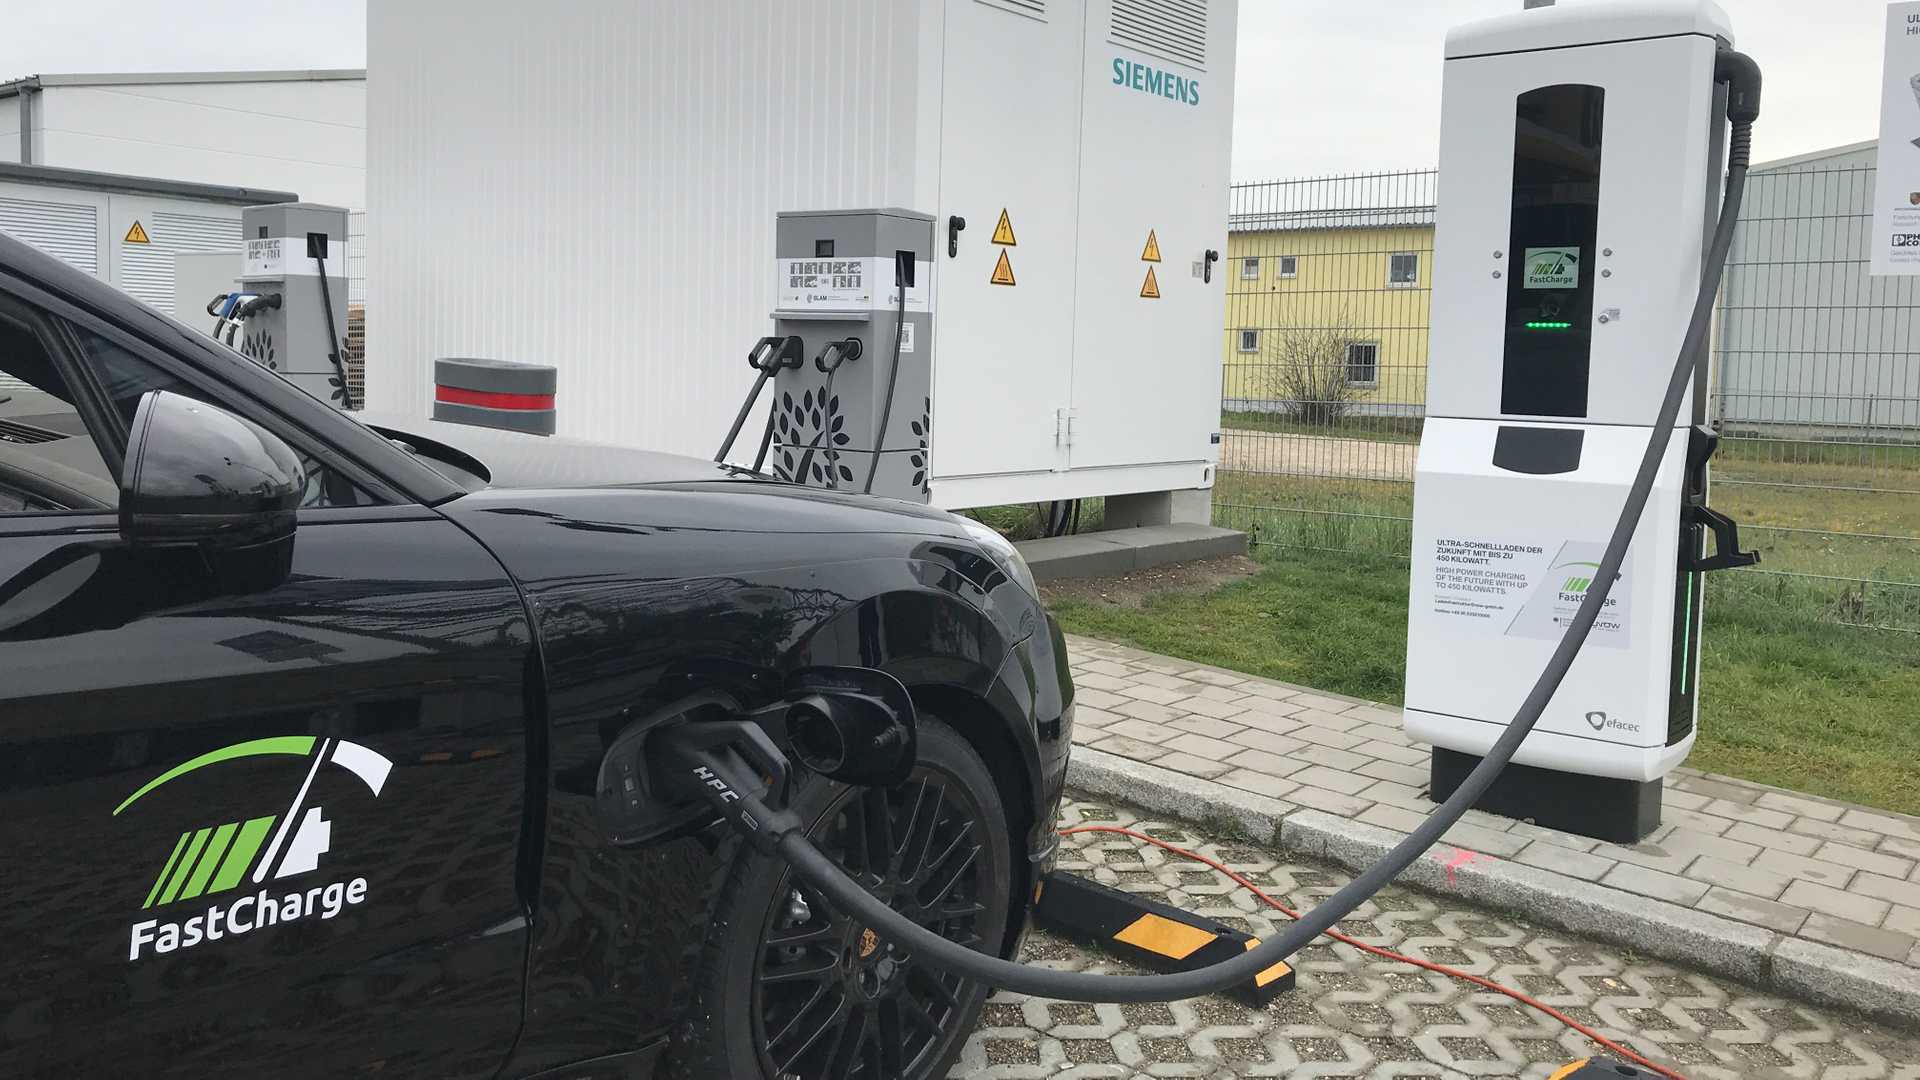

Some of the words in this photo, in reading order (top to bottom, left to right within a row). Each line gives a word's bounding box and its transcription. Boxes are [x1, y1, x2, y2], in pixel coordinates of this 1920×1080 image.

[1112, 57, 1200, 106] SIEMENS
[1529, 276, 1573, 284] FastCharge
[1436, 547, 1470, 556] ZUKUNFT
[1437, 539, 1524, 552] ULTRA-SCHNELLLADEN
[1456, 568, 1483, 577] POWER
[1485, 571, 1525, 580] CHARGING
[1464, 577, 1494, 586] FUTURE
[1558, 592, 1616, 606] FastCge
[1606, 718, 1640, 733] efacec
[692, 766, 740, 802] HPC
[129, 877, 368, 961] FastCharge
